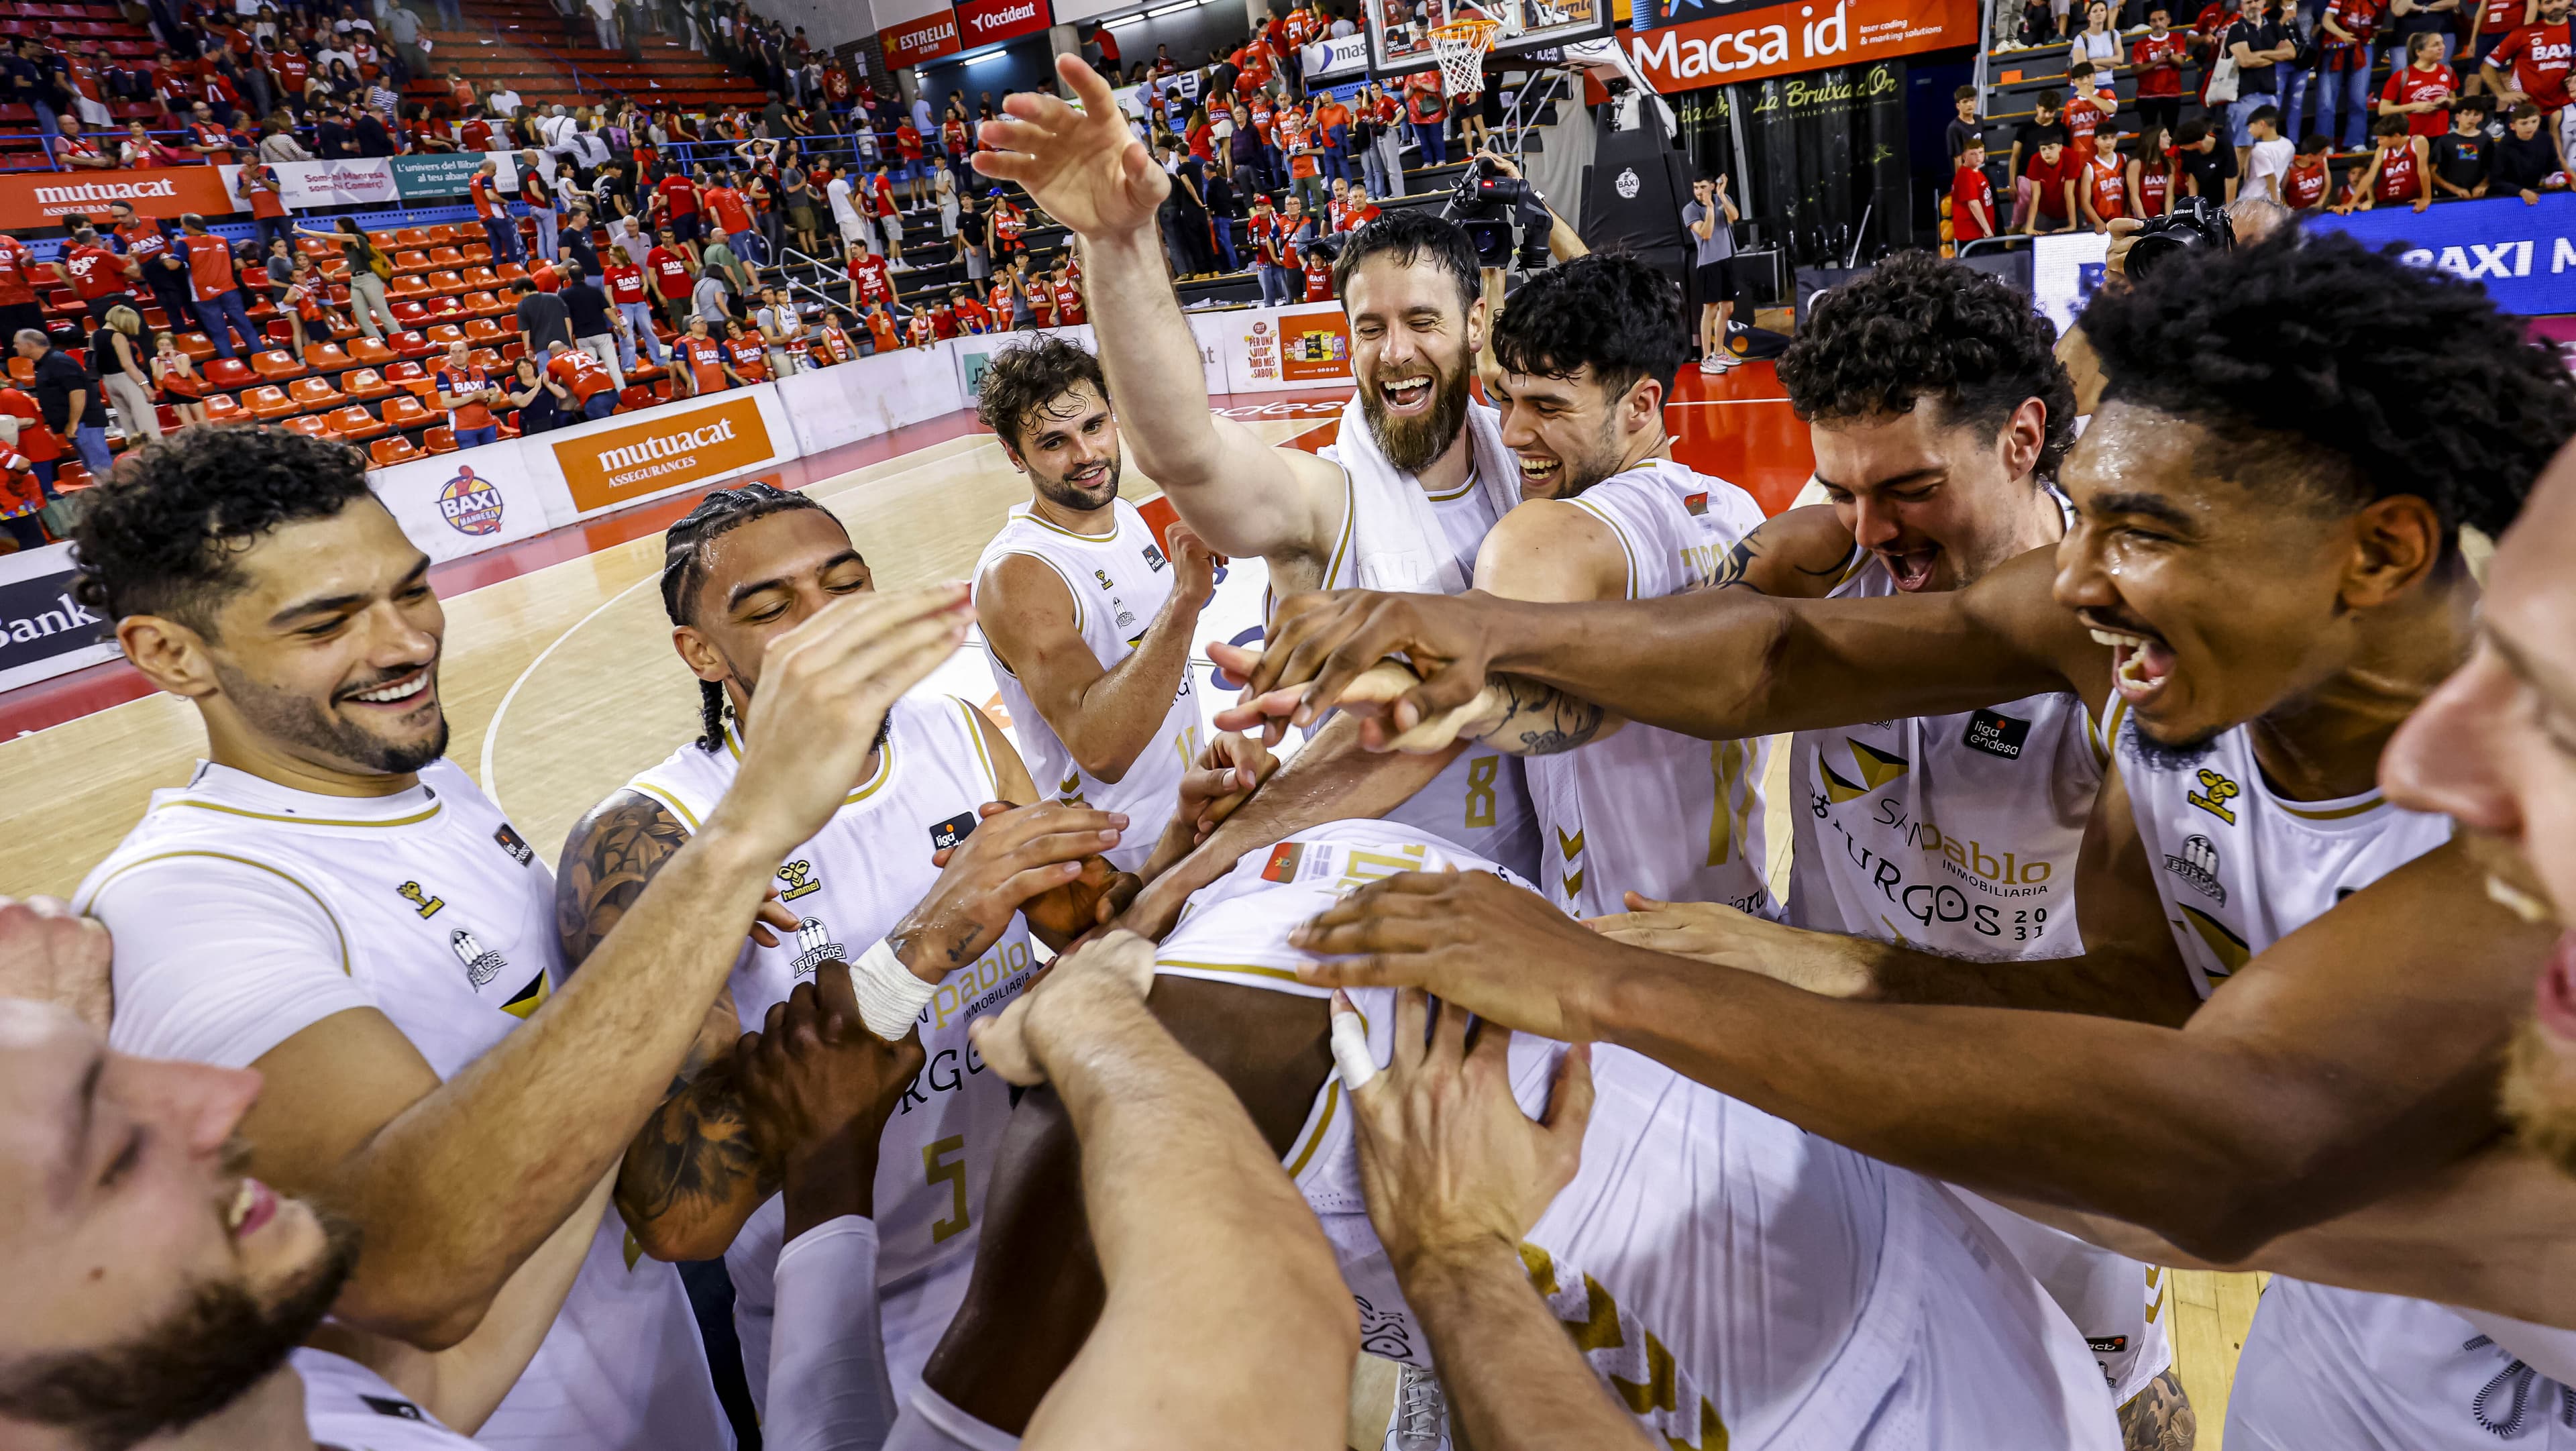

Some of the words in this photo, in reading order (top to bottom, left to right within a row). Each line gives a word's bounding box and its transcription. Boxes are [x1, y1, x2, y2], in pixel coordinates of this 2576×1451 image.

[985, 2, 1036, 29] Occident
[1288, 21, 1302, 39] 24
[1860, 25, 1879, 34] laser
[1880, 19, 1908, 30] coding
[1860, 36, 1868, 45] &
[1869, 32, 1903, 42] marking
[1904, 25, 1943, 38] solutions
[900, 22, 955, 50] ESTRELLA
[1387, 39, 1399, 48] liga
[1633, 23, 1789, 80] Macsa
[1801, 0, 1847, 58] id
[919, 44, 939, 54] DAMM
[1388, 43, 1411, 53] endesa
[2532, 38, 2571, 61] BAX
[1785, 80, 1853, 107] Bruixa
[441, 160, 455, 170] del
[305, 174, 341, 182] Som-hi
[417, 173, 427, 183] al
[429, 172, 443, 182] teu
[445, 172, 469, 181] abast
[1618, 178, 1639, 188] BAXI
[34, 178, 177, 204] mutuacat
[309, 183, 343, 193] som-hi
[43, 203, 112, 217] ASSEGURAN
[2173, 207, 2194, 215] Nikon
[661, 261, 683, 270] BAX
[1249, 337, 1260, 347] PER
[1261, 335, 1273, 345] UNA
[564, 352, 596, 370] 25
[696, 350, 719, 360] BAXI
[735, 347, 763, 360] BAXI
[1253, 347, 1268, 357] VIDA
[1250, 358, 1263, 368] AMB
[1253, 368, 1273, 378] SABOR
[453, 379, 485, 392] BAXI
[597, 417, 737, 472] mutuacat
[608, 455, 697, 489] ASSEGURANCES
[441, 488, 502, 519] BAXI
[459, 509, 498, 527] MANRESA
[1974, 720, 2001, 738] liga
[1970, 734, 2019, 756] endesa
[1465, 755, 1499, 829] 8
[936, 832, 956, 847] liga
[1833, 819, 2001, 936] URGOS
[1943, 859, 2048, 898] INMOBILIARIA
[782, 879, 820, 902] hummel
[469, 952, 503, 984] BURGOS
[796, 946, 843, 973] BURGOS
[932, 941, 1028, 1031] pablo
[963, 971, 1030, 1023] INMOBILIARIA
[922, 1134, 971, 1246] 5
